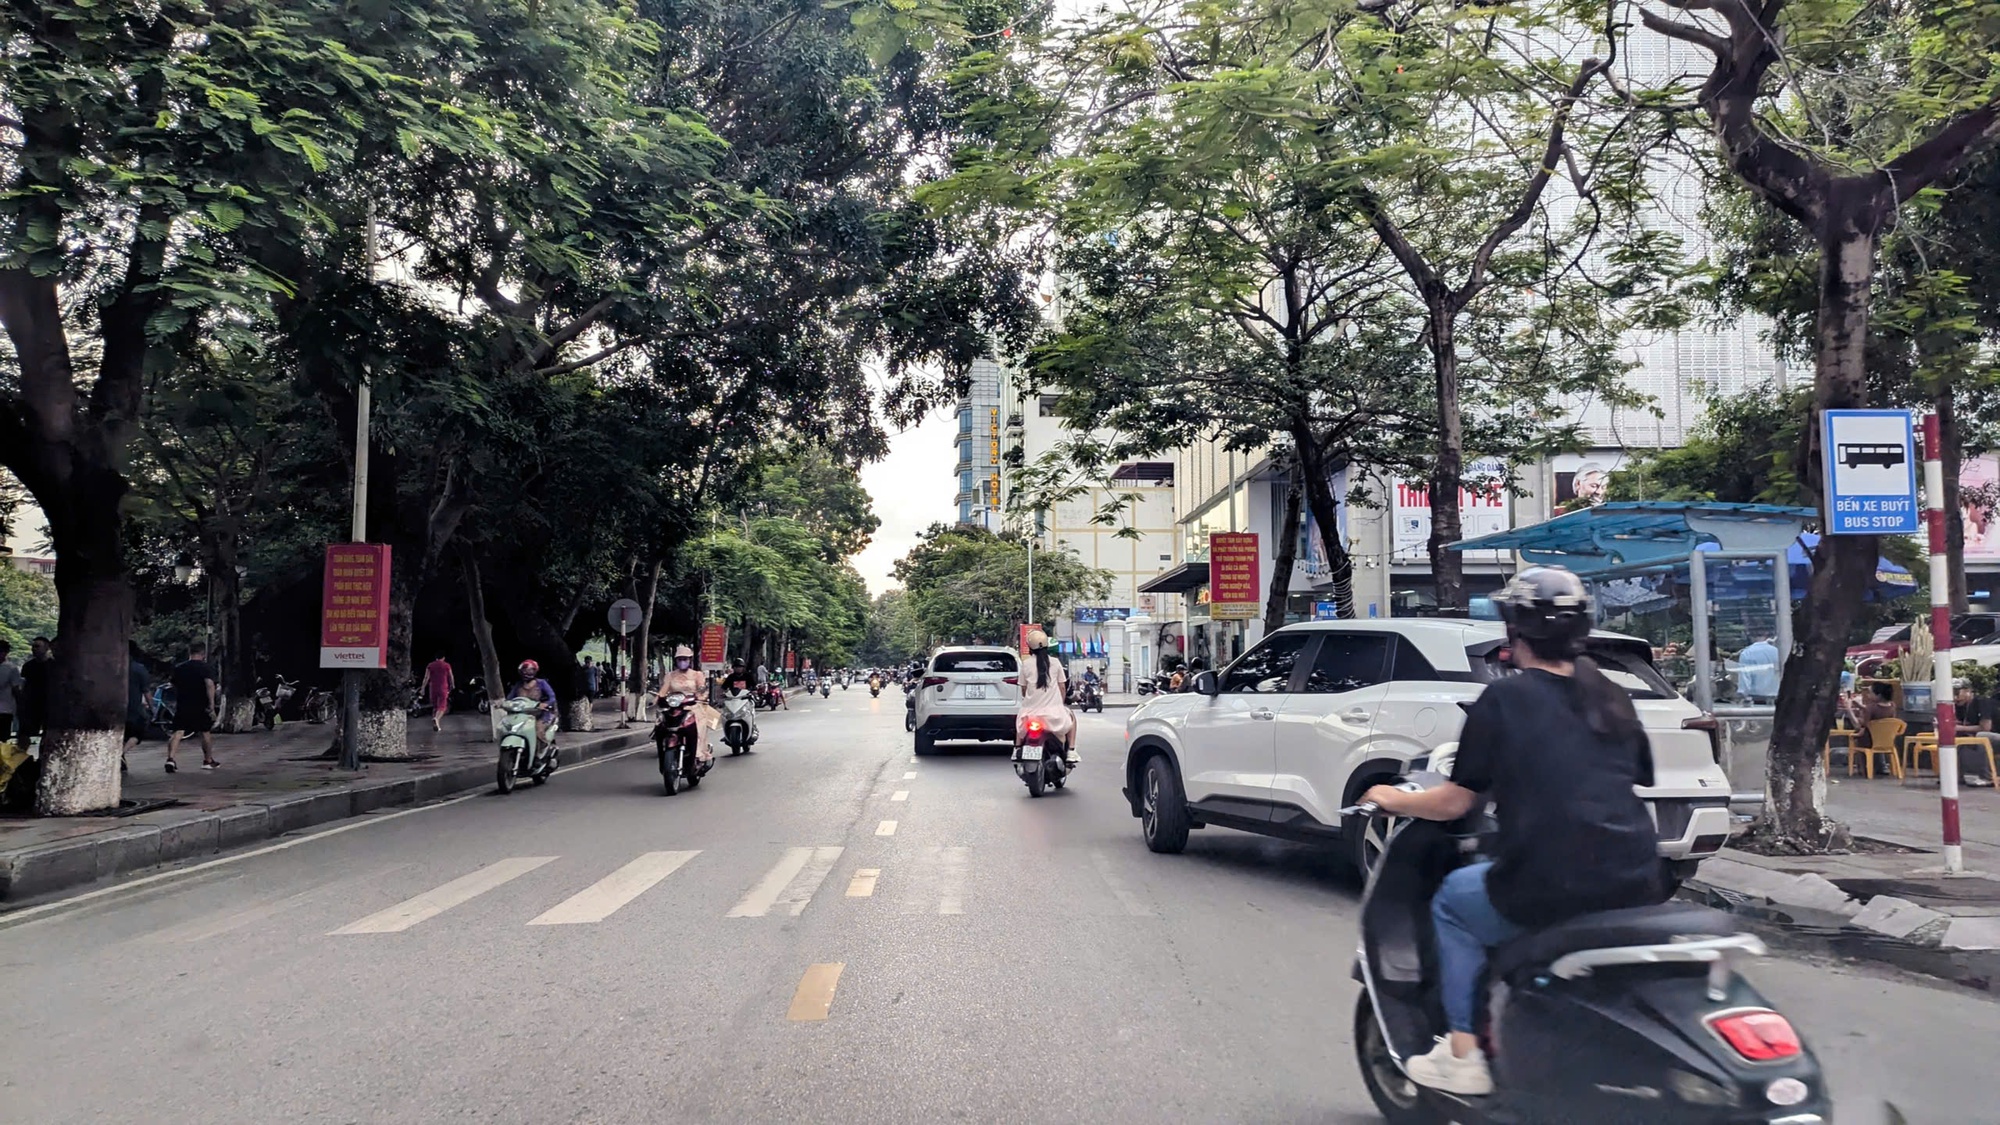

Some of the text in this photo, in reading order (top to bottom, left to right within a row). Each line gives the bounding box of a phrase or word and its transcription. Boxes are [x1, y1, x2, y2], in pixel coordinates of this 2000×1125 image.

[1837, 496, 1910, 512] BẾN XE BUÝT
[1844, 516, 1904, 528] BUS STOP
[334, 652, 366, 660] viettel
